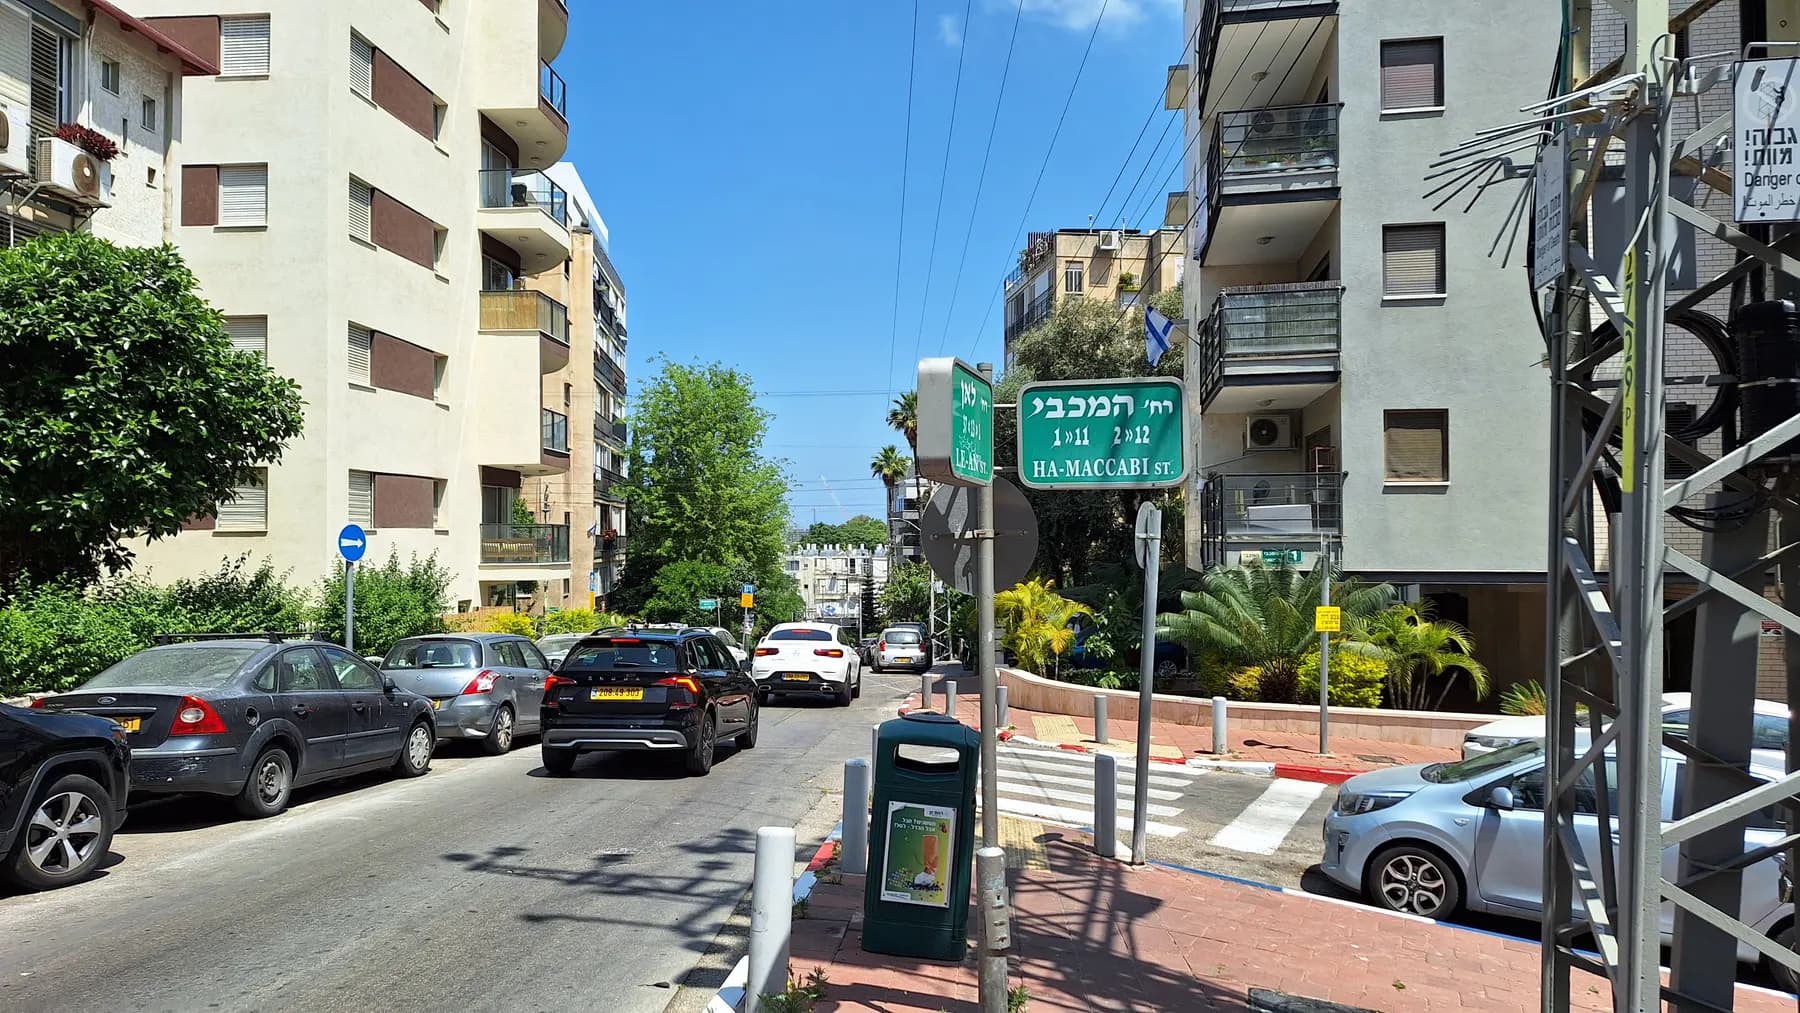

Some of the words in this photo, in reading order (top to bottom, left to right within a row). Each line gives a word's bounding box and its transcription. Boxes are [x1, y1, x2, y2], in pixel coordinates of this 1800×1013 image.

[1745, 127, 1798, 147] גבוה!
[1744, 147, 1793, 167] מוות!
[1744, 171, 1793, 190] Danger
[961, 379, 977, 411] לאן
[1026, 393, 1135, 420] המכבי
[1143, 398, 1174, 416] רח'
[1032, 457, 1150, 478] HA-MACCABI
[1153, 461, 1175, 476] ST.
